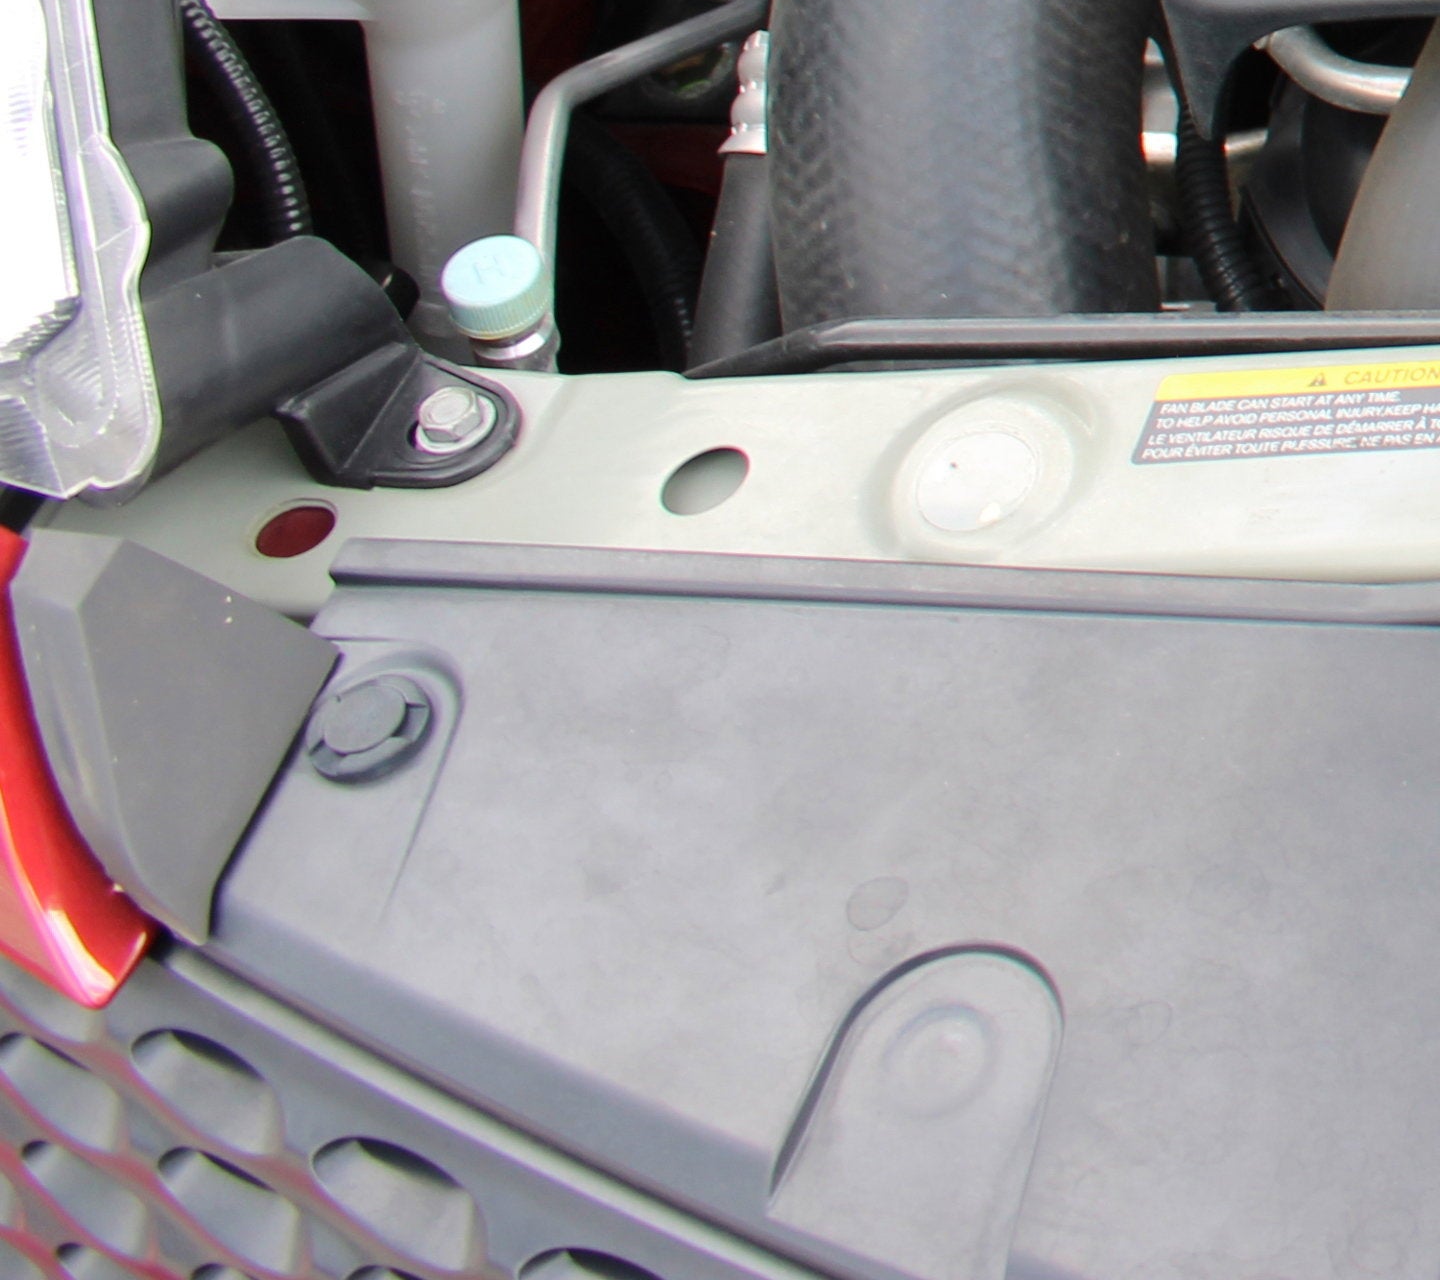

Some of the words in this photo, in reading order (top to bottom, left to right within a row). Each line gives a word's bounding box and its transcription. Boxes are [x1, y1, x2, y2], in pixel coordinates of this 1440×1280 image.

[1160, 402, 1188, 414] FAN
[1189, 400, 1236, 413] BLADE
[1237, 398, 1268, 412] CAN
[1270, 395, 1314, 409] START
[1313, 394, 1334, 407] AT
[1334, 392, 1366, 405] ANY
[1148, 432, 1166, 446] LE
[1168, 427, 1258, 445] VENTILATEUR
[1258, 424, 1313, 440] RISQUE
[1313, 422, 1335, 436] DE
[1335, 418, 1415, 435] DÉMARRER
[1415, 416, 1428, 431] À
[1156, 417, 1175, 430] TO
[1176, 415, 1214, 428] HELP
[1214, 412, 1259, 427] AVOID
[1260, 408, 1334, 425] PERSONAL
[1141, 446, 1185, 460] POUR
[1184, 442, 1234, 458] ÉVITER
[1235, 440, 1280, 455] TOUTE
[1358, 434, 1382, 447] NE
[1382, 432, 1413, 446] PAS
[1414, 431, 1436, 445] EN
